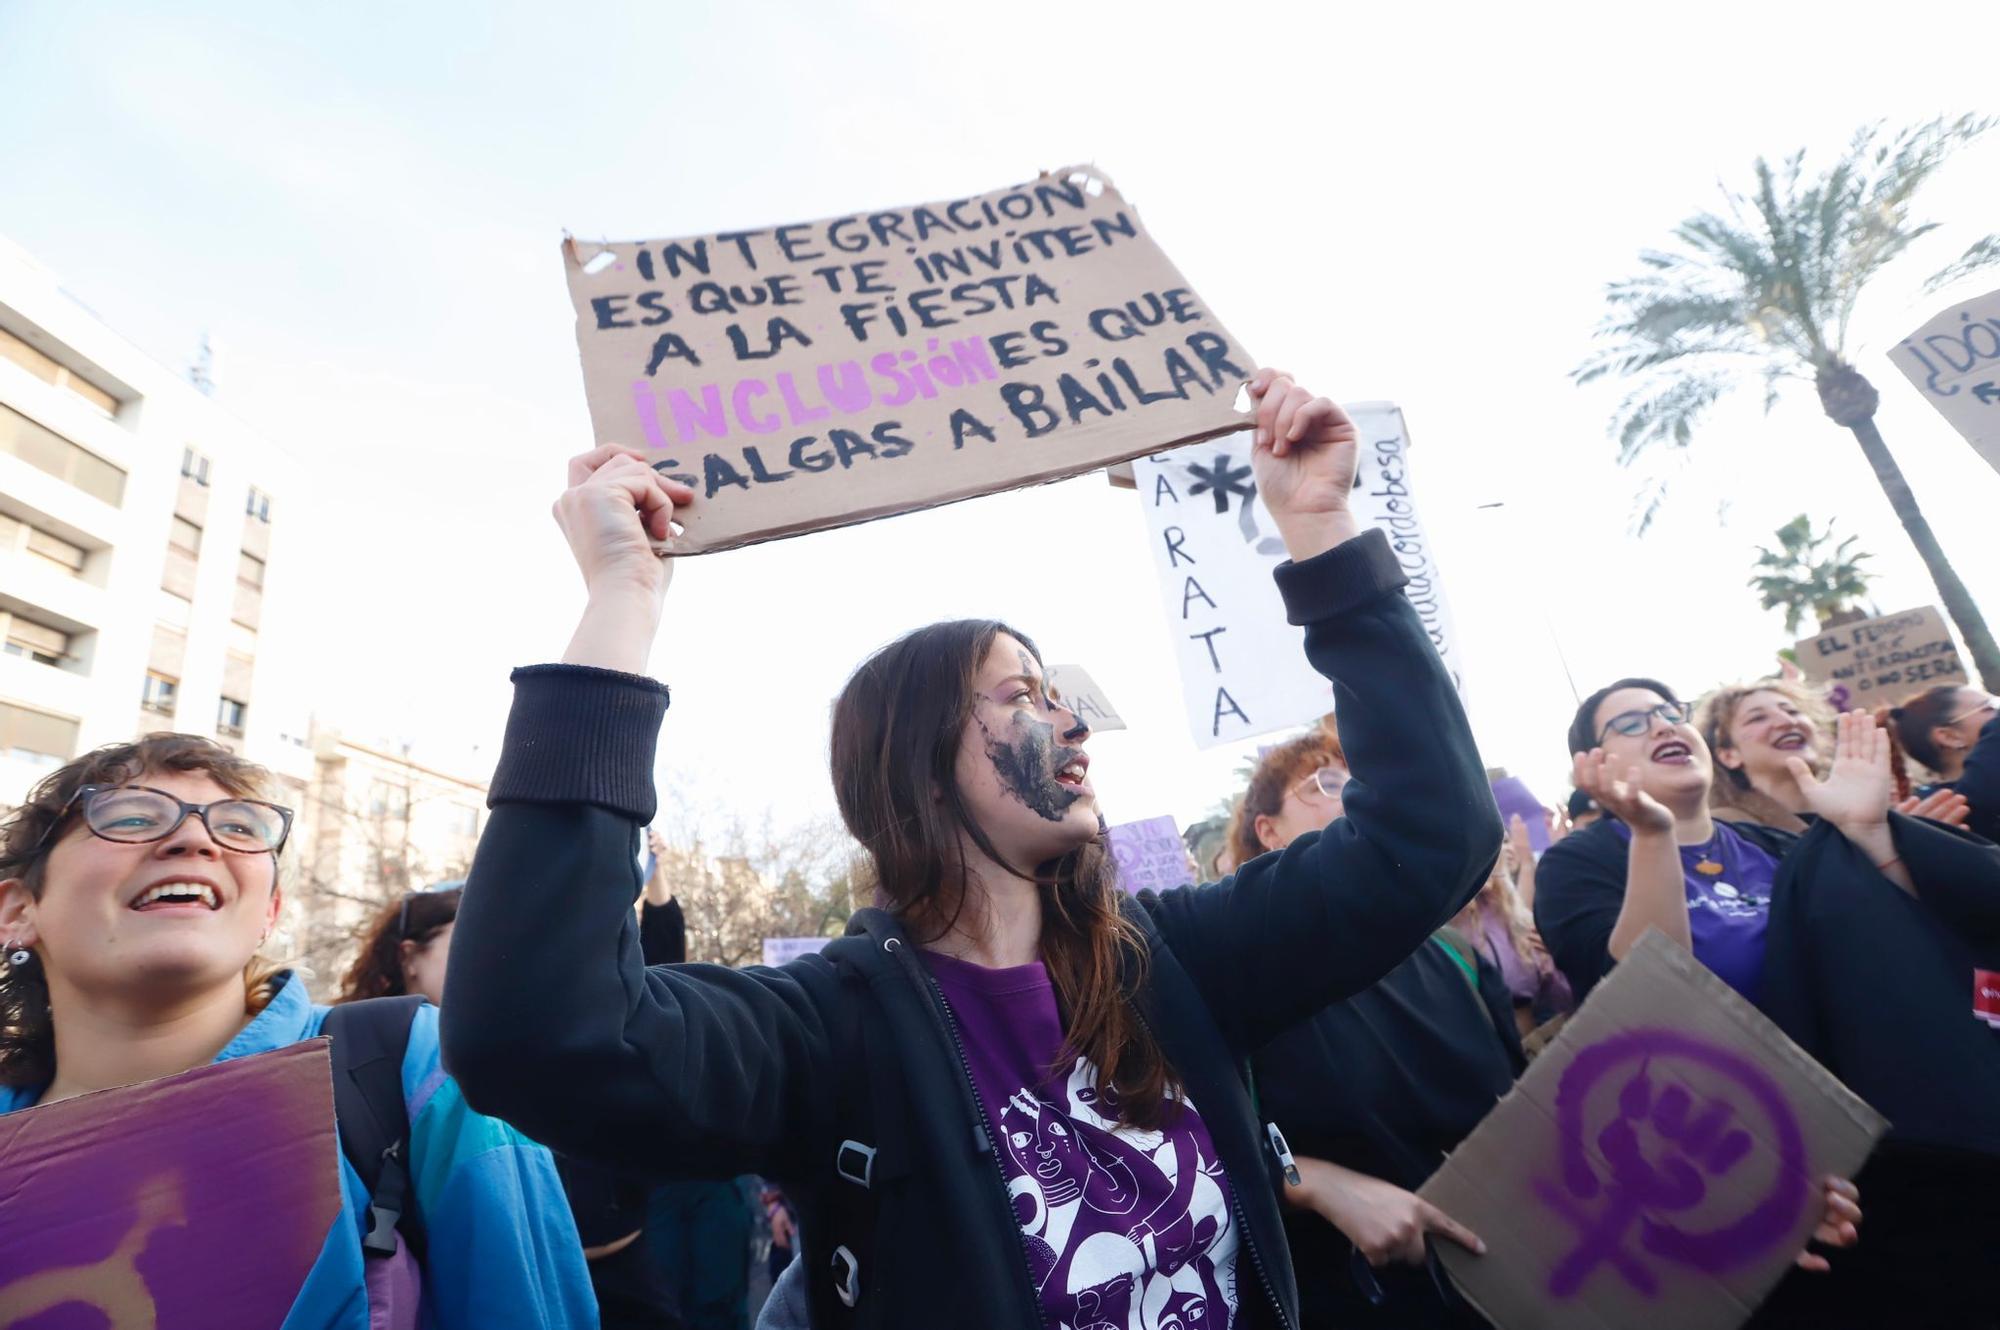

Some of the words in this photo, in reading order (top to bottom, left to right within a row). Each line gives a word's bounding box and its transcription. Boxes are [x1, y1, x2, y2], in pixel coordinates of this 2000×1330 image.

[590, 291, 674, 330] ES
[687, 274, 806, 315] QUE
[811, 260, 897, 294] TE
[905, 211, 1137, 284] INVITEN
[644, 332, 703, 377] A
[725, 316, 813, 361] LA
[840, 273, 1060, 342] FIESTA
[988, 320, 1069, 369] ES
[1088, 288, 1202, 341] QUE
[950, 408, 997, 450] A
[1000, 331, 1249, 438] BAILAR
[1816, 635, 1849, 657] EL
